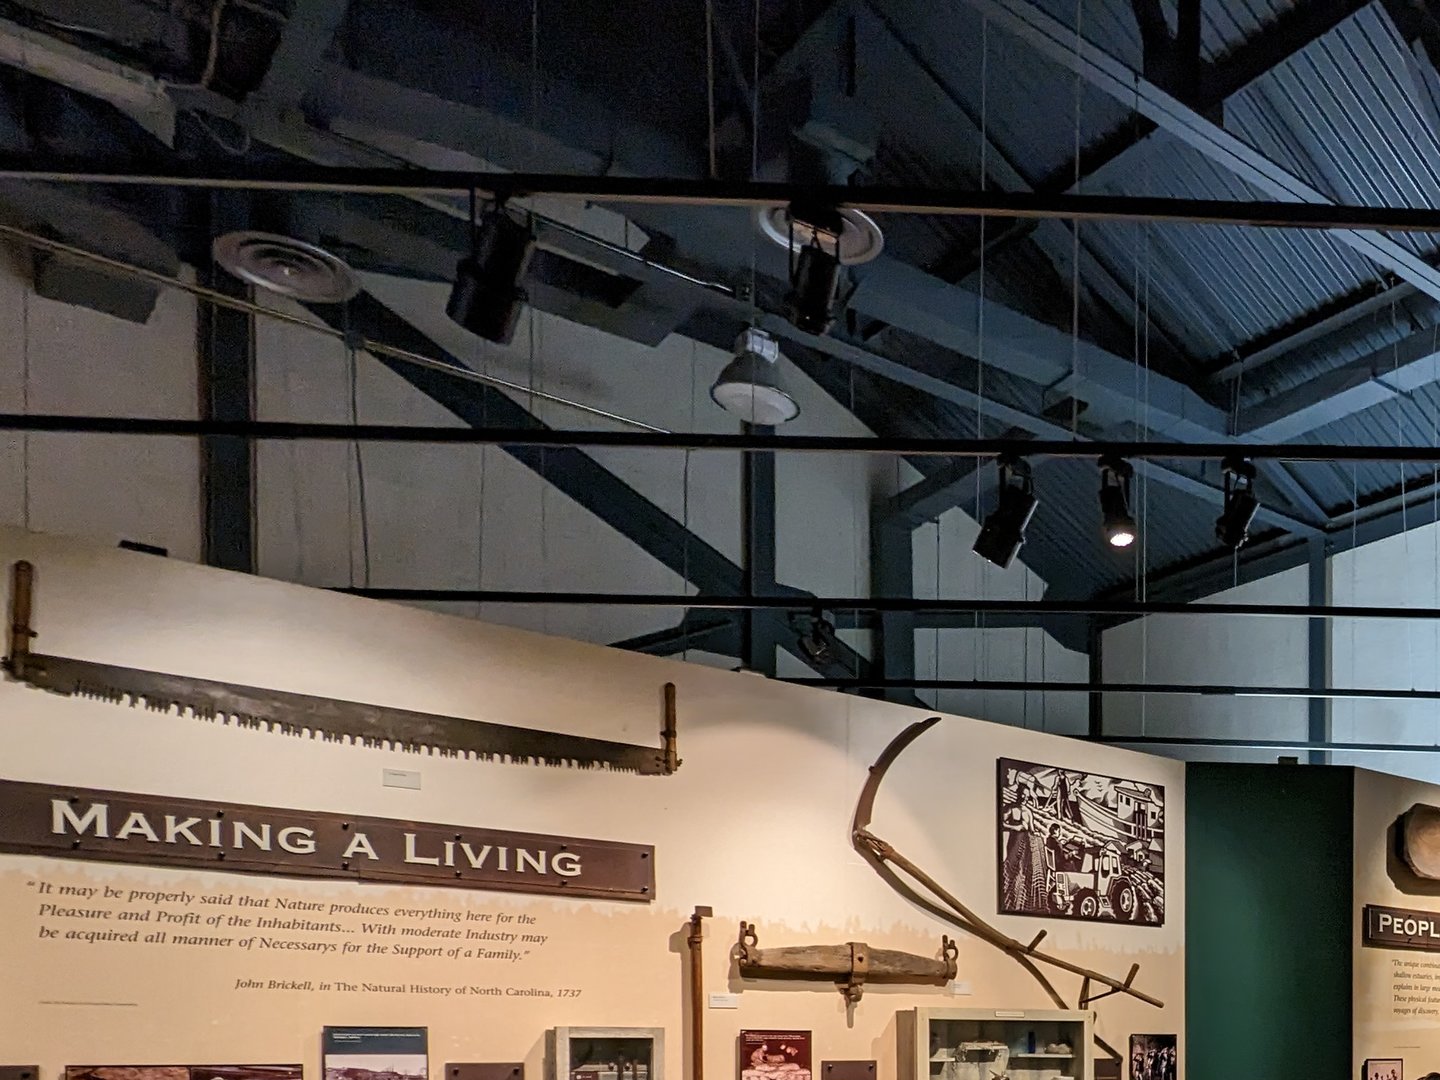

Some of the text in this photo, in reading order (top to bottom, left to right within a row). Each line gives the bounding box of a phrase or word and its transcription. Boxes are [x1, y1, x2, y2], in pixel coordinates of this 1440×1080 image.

[52, 799, 582, 877] MAKING A LIVING
[39, 904, 548, 945] Pleasure and Profit of the Inhabitants... With moderate Industry may
[59, 886, 98, 899] may
[104, 886, 123, 898] be
[128, 890, 195, 905] properly
[200, 894, 233, 905] said
[238, 896, 270, 908] that
[275, 898, 324, 911] Nature
[329, 903, 389, 915] produces
[394, 908, 461, 922] everything
[466, 911, 492, 922] here
[496, 912, 513, 925] for
[518, 914, 536, 925] the
[39, 926, 59, 938] be
[66, 929, 138, 943] acquired
[145, 932, 166, 943] all
[172, 935, 233, 947] manner
[238, 937, 256, 950] of
[260, 937, 337, 954] Necessarys
[342, 942, 362, 955] for
[367, 943, 388, 954] the
[392, 944, 443, 958] Support
[448, 947, 462, 959] of
[235, 979, 581, 997] John Brickell, in The Natural History of North Carolina, 1737
